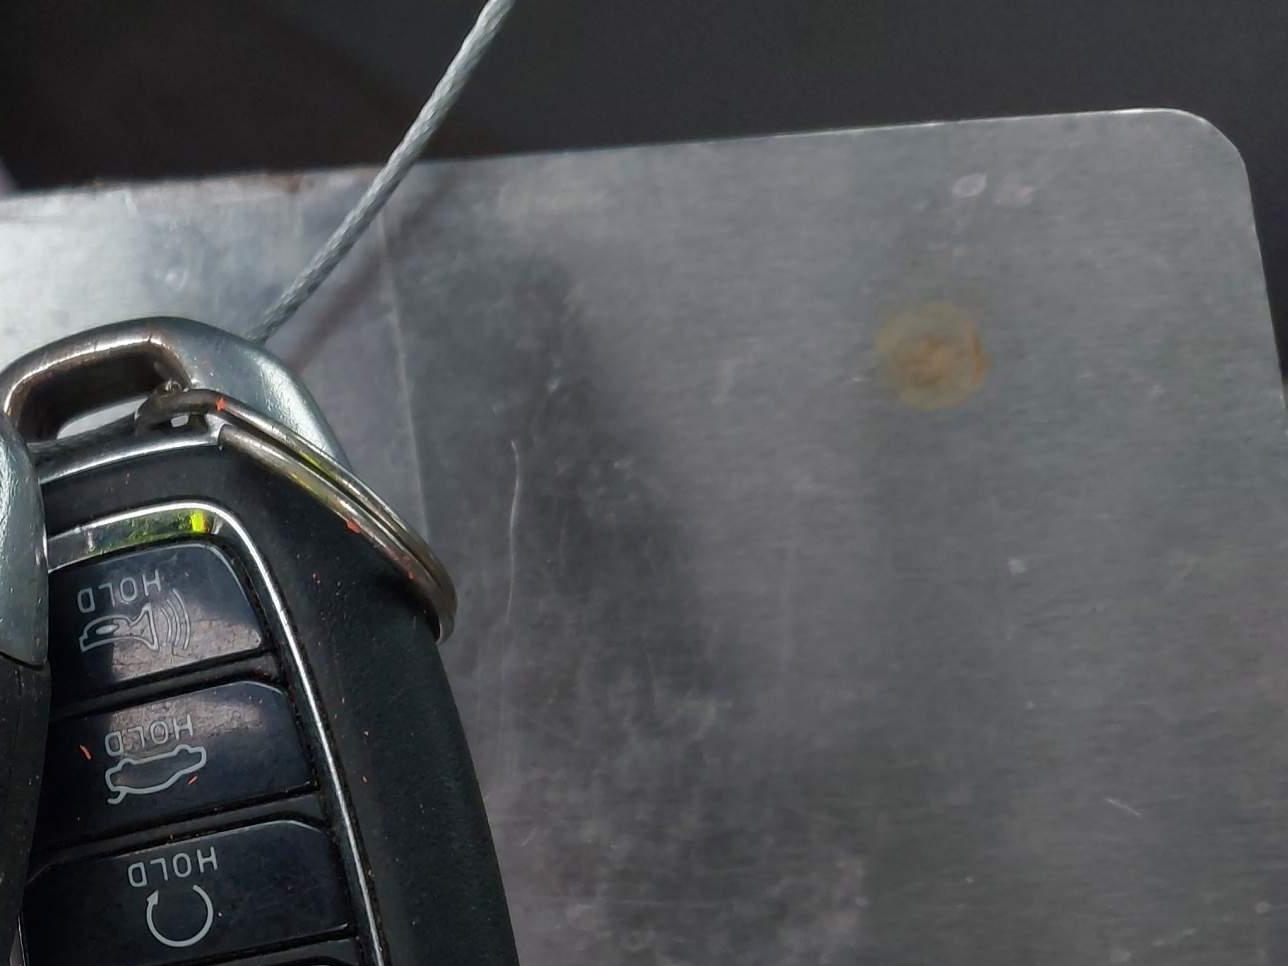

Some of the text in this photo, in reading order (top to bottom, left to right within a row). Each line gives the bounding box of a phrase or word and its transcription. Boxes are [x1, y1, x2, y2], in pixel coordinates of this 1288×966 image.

[78, 569, 162, 613] HOLD
[105, 714, 194, 754] HOLD
[127, 846, 219, 887] HOLD
